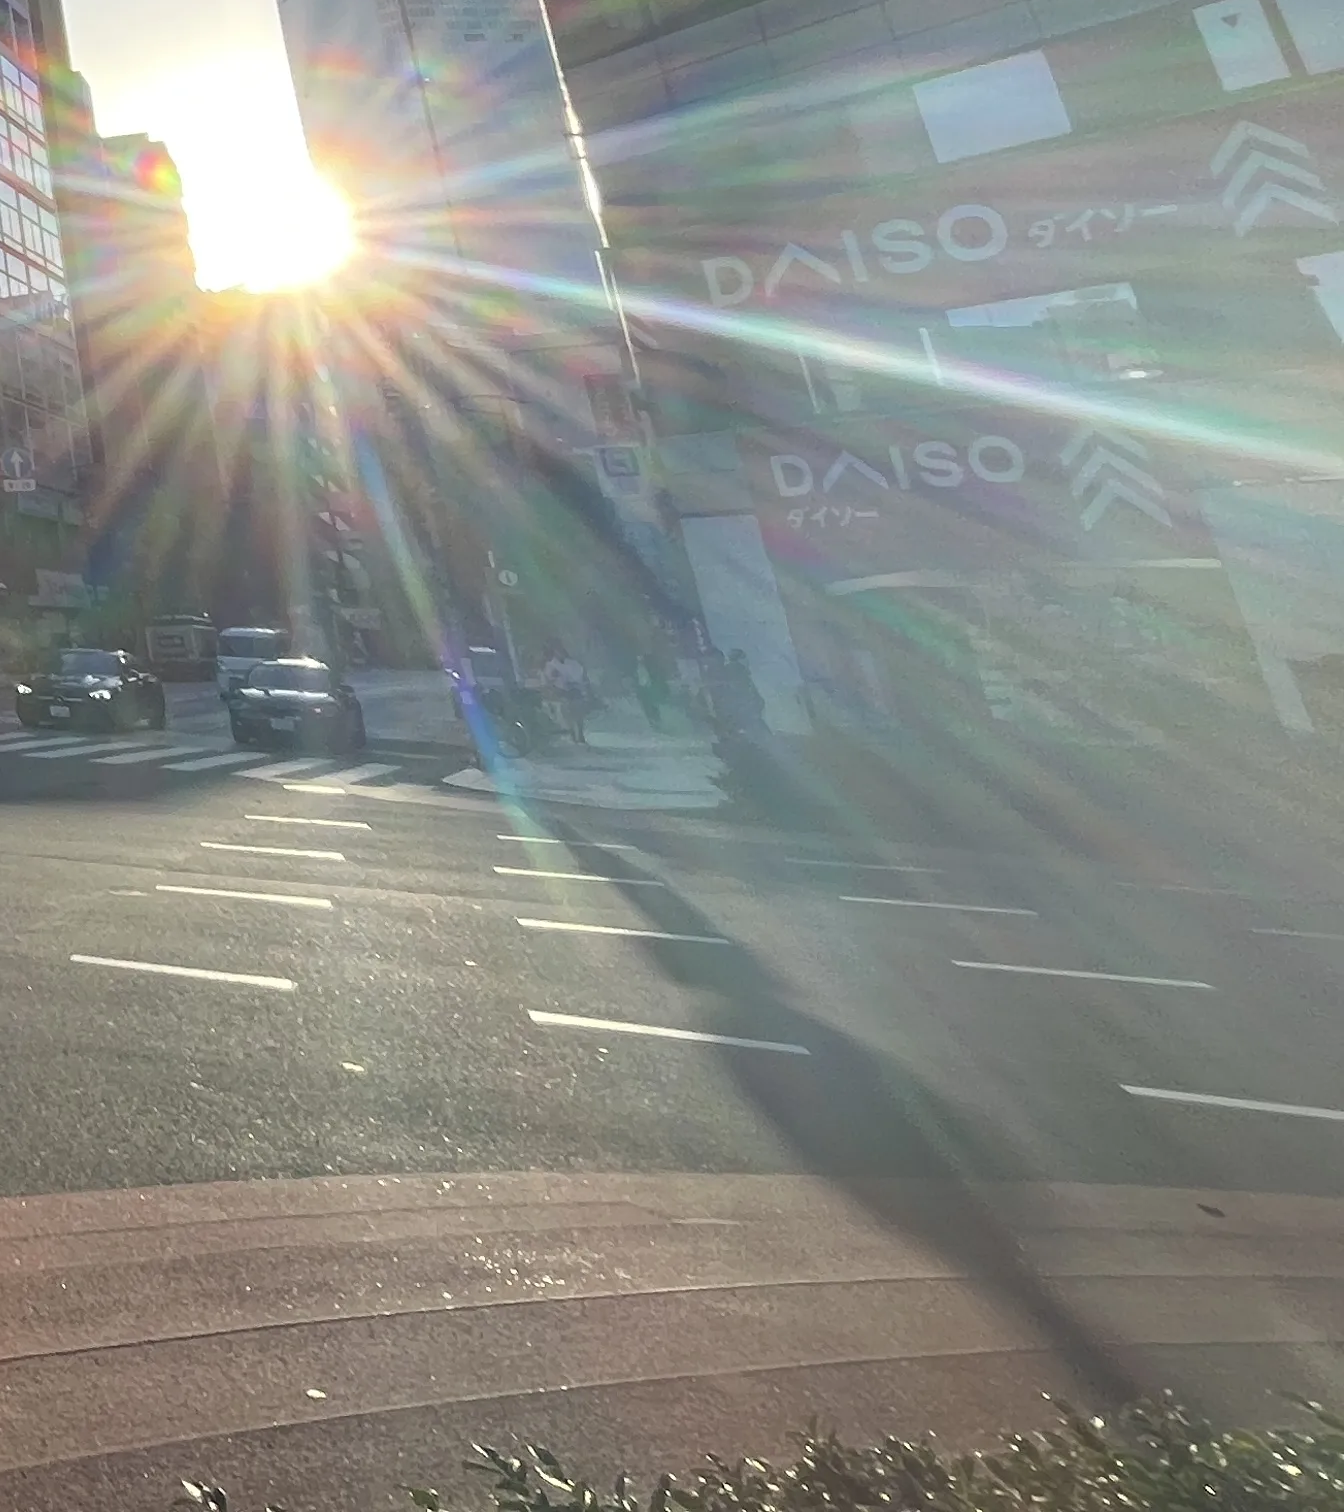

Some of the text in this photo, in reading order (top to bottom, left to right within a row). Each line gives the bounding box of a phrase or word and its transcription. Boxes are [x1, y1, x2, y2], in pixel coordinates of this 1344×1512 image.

[1027, 203, 1179, 248] ダイソー
[701, 204, 1009, 308] DAISO
[769, 434, 1025, 498] DAISO
[786, 505, 880, 530] ダイソー
